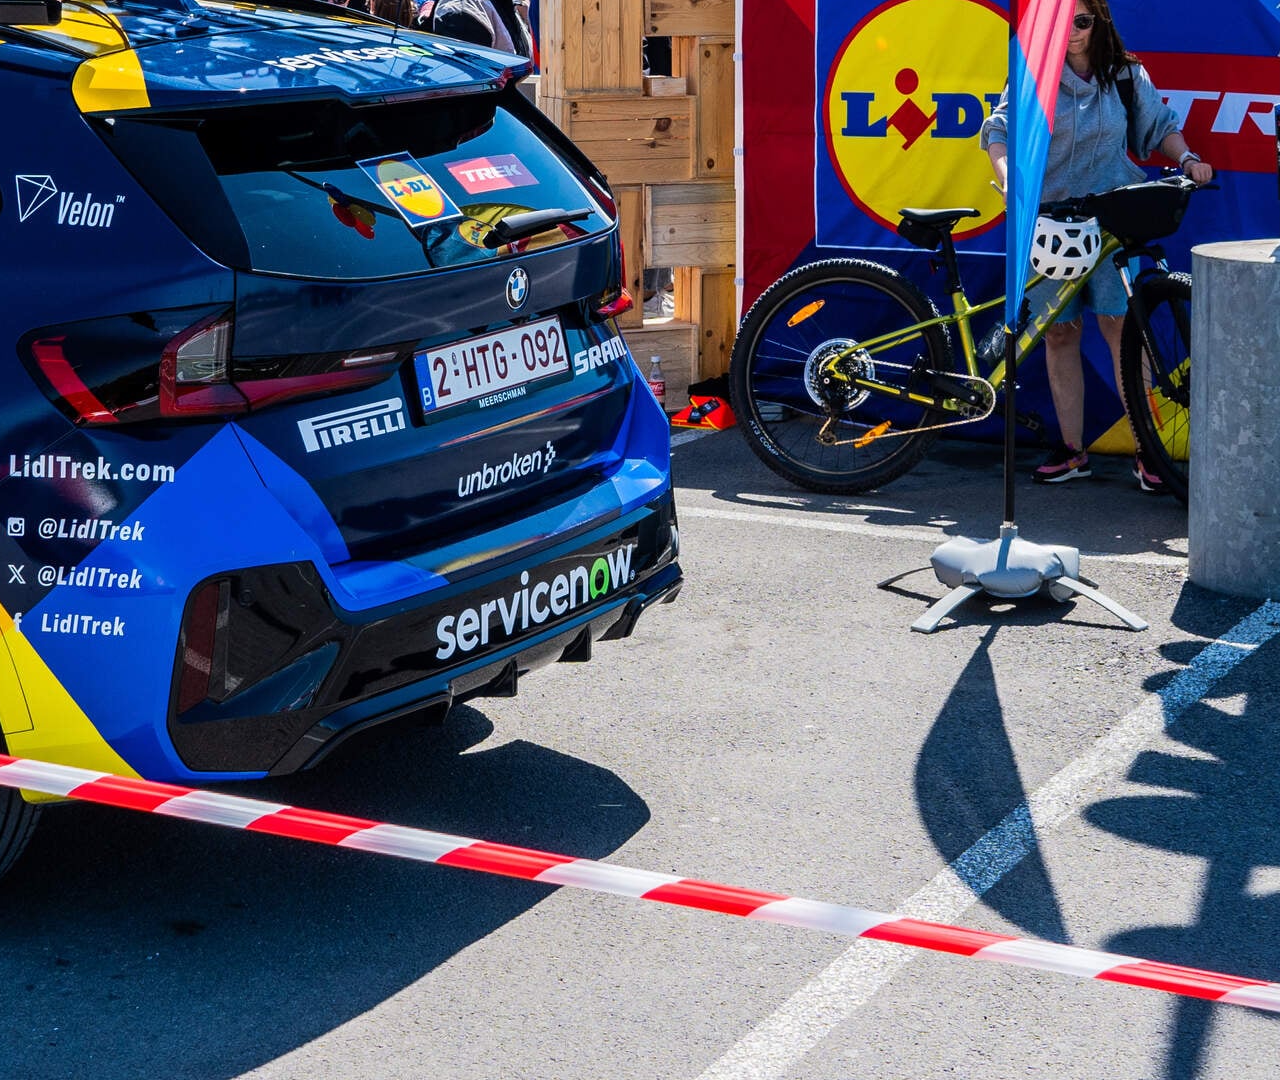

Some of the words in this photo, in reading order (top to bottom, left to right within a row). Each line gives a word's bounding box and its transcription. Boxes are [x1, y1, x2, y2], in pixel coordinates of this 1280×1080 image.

[460, 165, 523, 182] TREK
[574, 335, 628, 376] SRAM
[422, 387, 433, 406] B
[478, 386, 527, 408] MEERSCHMAN
[297, 397, 406, 452] PIRELLI
[9, 454, 175, 483] LidlTrek.com
[458, 448, 542, 497] unbroken
[37, 519, 144, 542] @LidlTrek
[37, 566, 143, 590] @LidlTrek
[41, 613, 125, 637] LidlTrek
